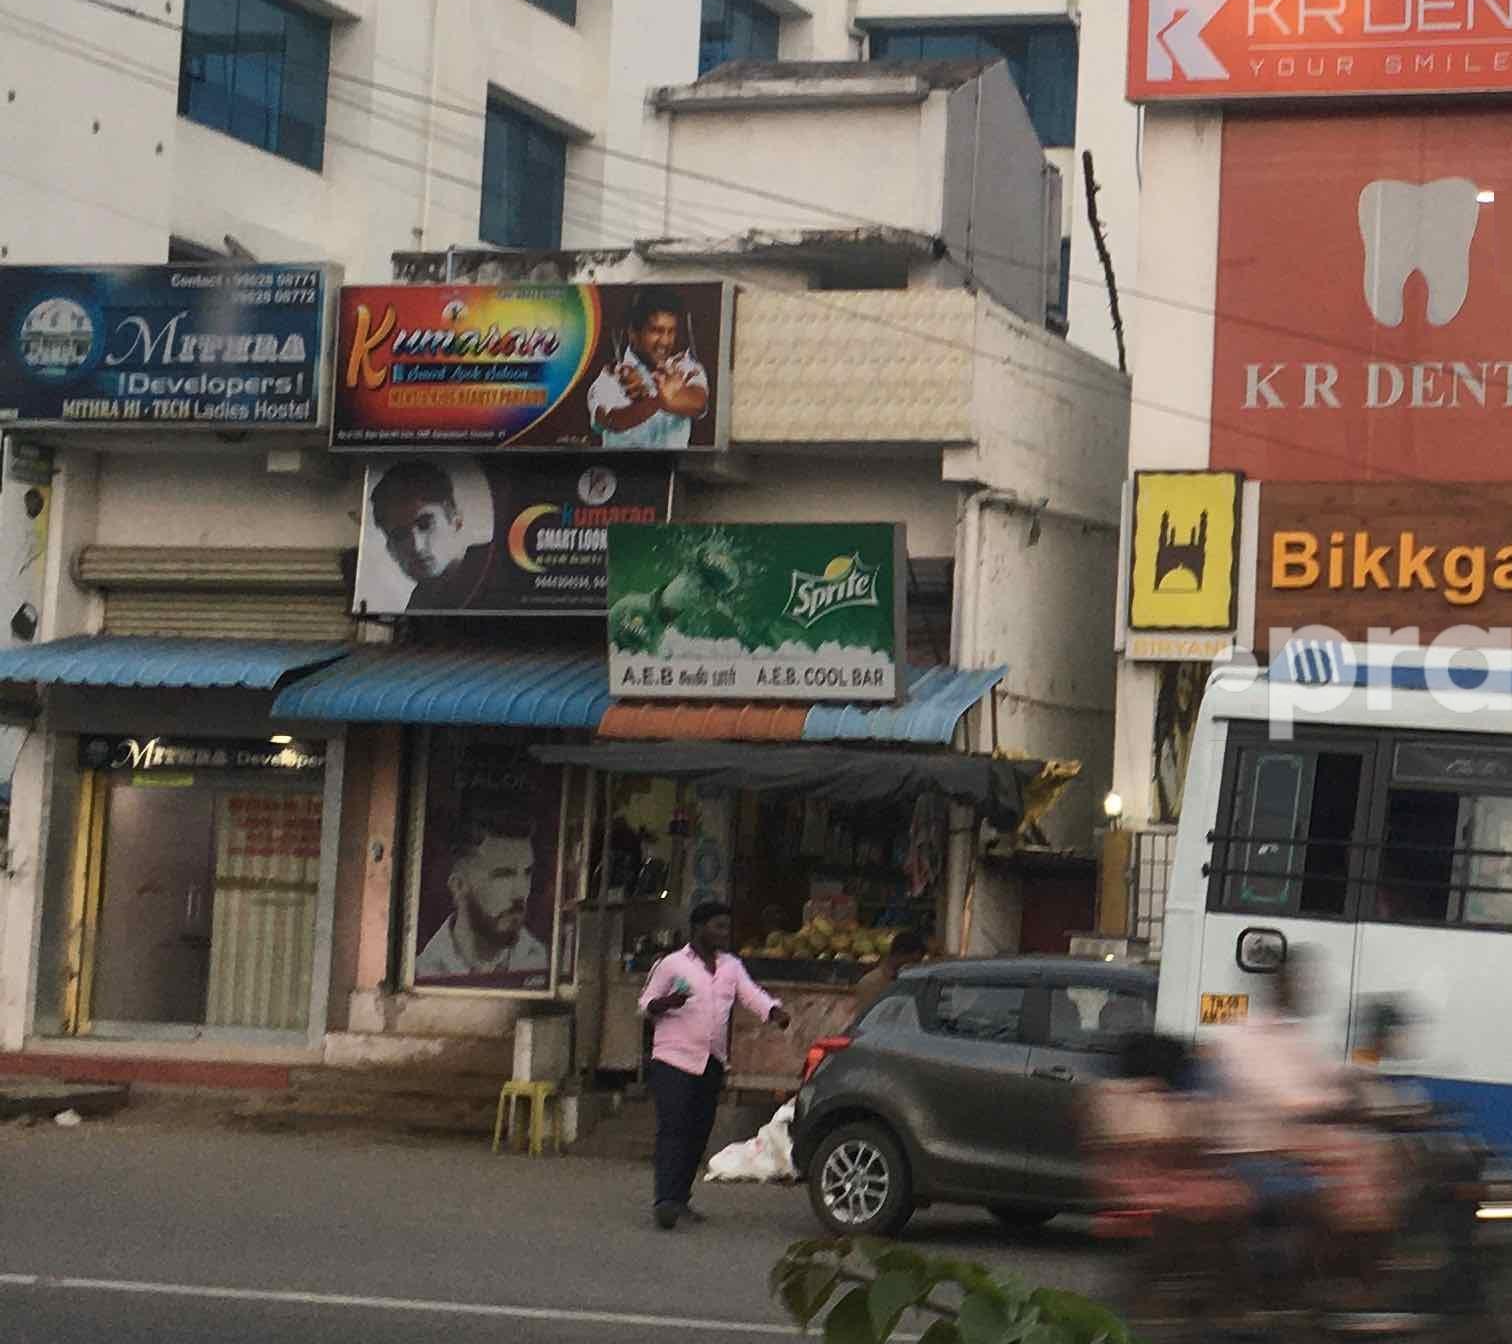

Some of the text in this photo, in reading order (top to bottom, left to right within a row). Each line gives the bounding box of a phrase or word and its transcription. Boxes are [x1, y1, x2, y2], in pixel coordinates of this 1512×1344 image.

[1249, 55, 1354, 78] YOUR
[1385, 49, 1512, 76] SMILE
[346, 304, 561, 390] Kumaran
[128, 372, 293, 398] Developers
[535, 527, 577, 552] SMART
[791, 571, 871, 617] Sprite
[803, 667, 848, 687] COOL
[851, 667, 883, 687] BAR
